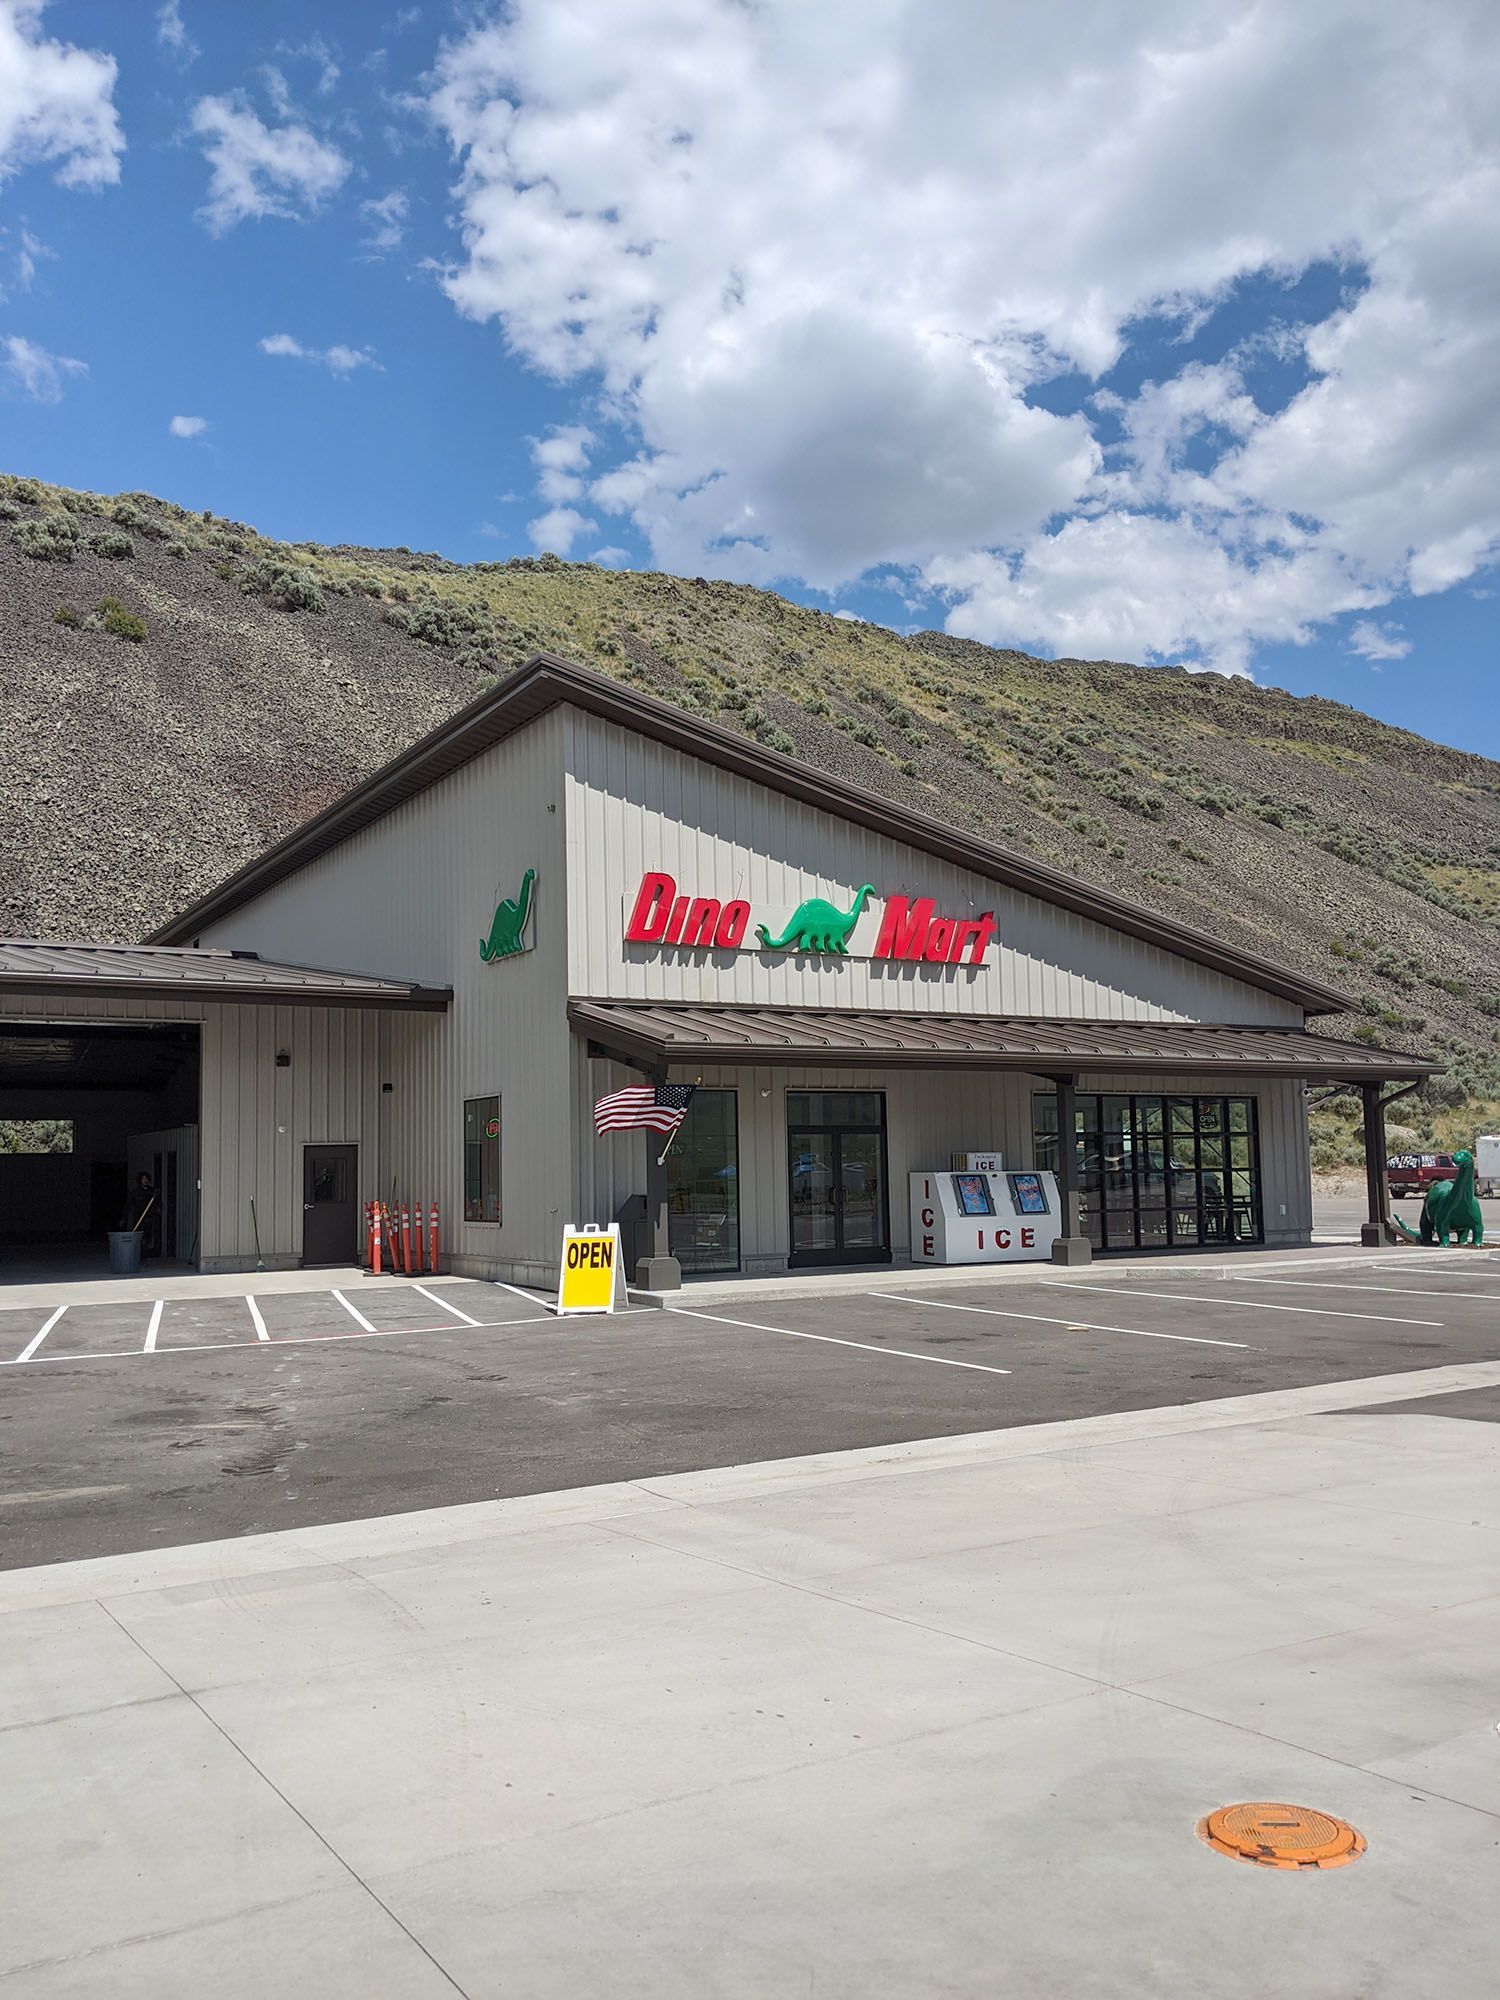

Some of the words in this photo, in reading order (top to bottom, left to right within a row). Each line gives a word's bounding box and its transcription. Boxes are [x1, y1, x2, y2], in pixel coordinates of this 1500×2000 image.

[624, 872, 751, 949] Dino
[872, 895, 997, 965] Mart
[975, 1161, 995, 1170] ICE
[921, 1179, 935, 1257] ICE
[977, 1227, 1036, 1250] ICE
[567, 1241, 613, 1269] OPEN
